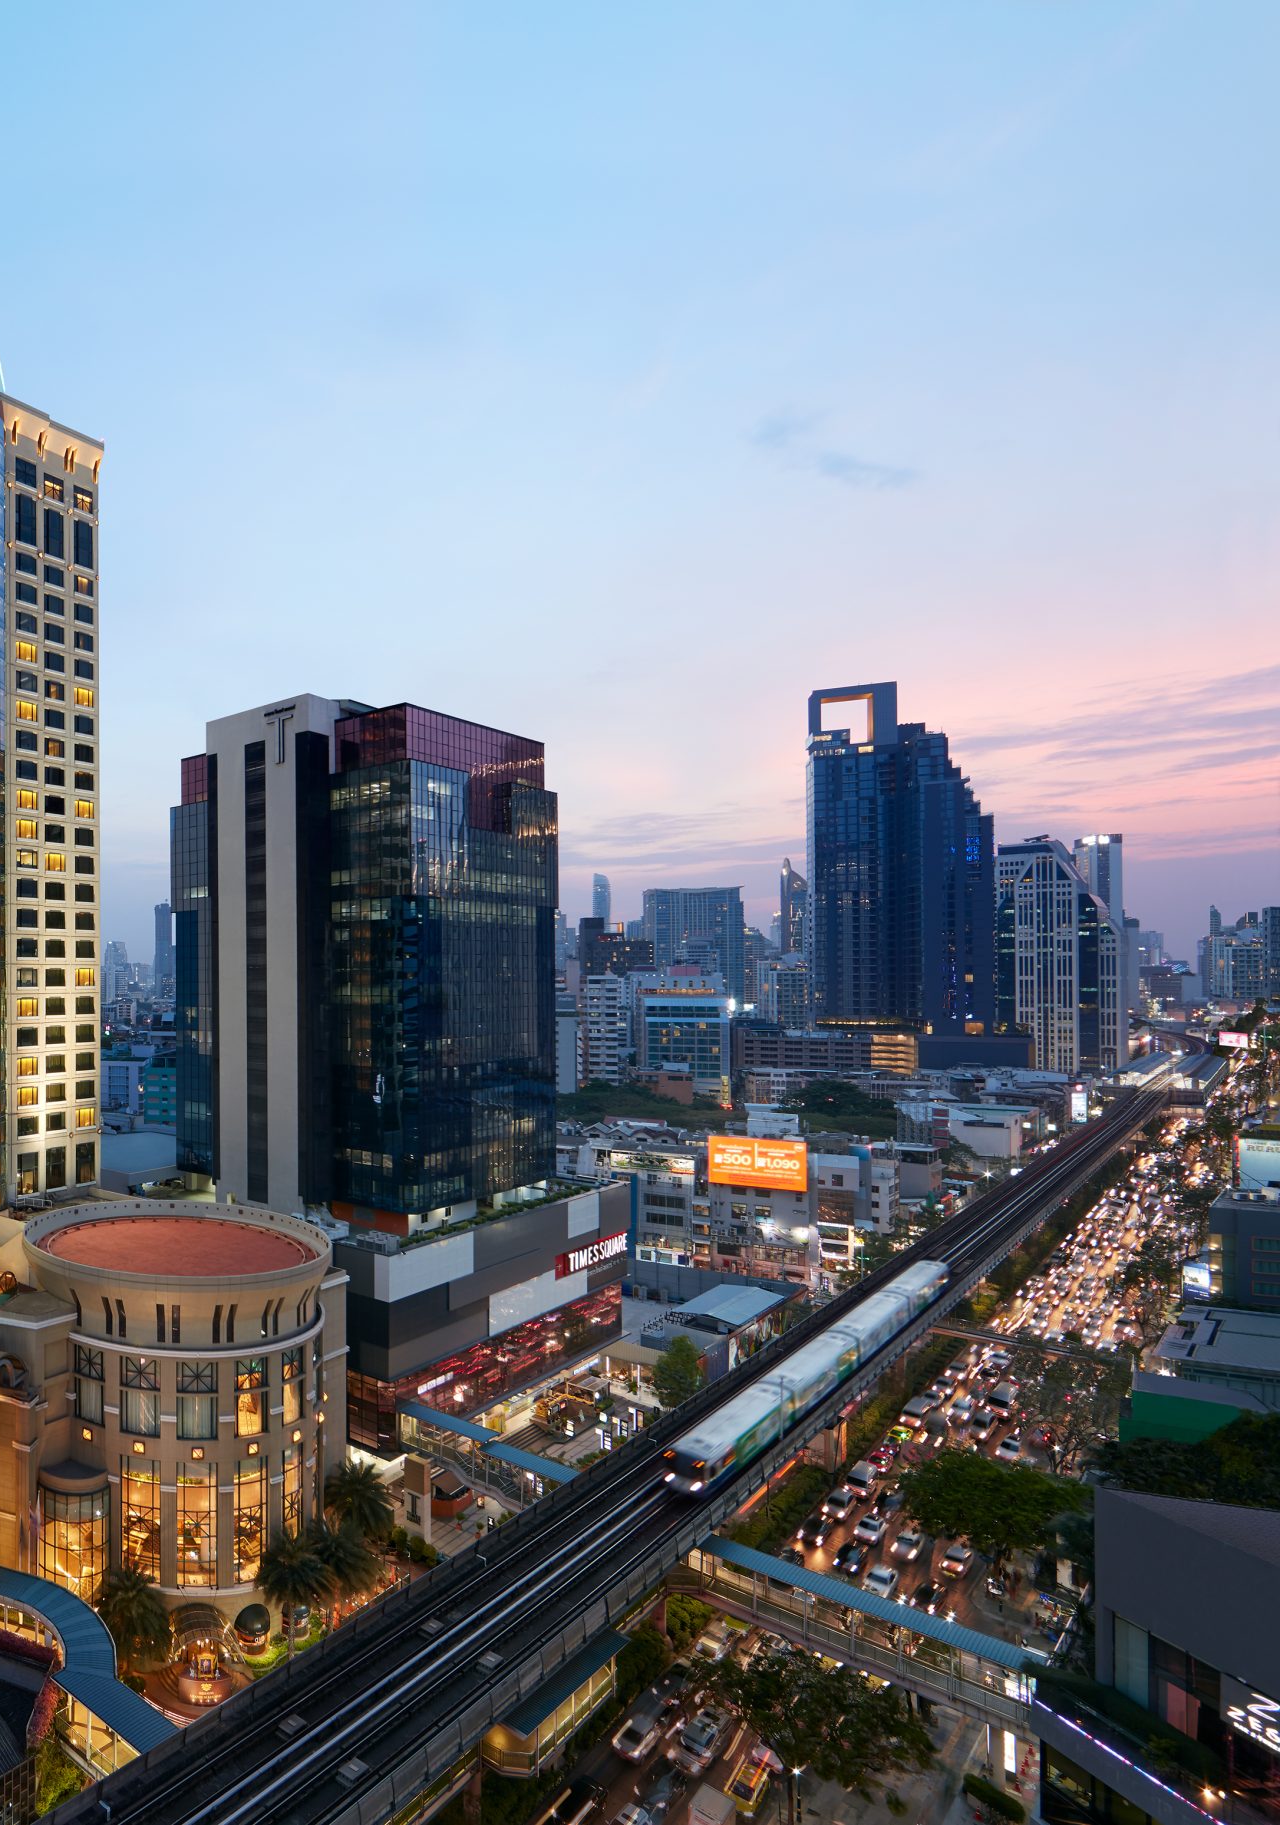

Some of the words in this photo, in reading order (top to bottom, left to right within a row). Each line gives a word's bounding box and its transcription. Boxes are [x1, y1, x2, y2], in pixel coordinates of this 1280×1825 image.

[722, 1153, 752, 1166] 500
[766, 1156, 800, 1170] 1,090
[568, 1244, 599, 1273] TIMES
[599, 1233, 628, 1260] SQUARE
